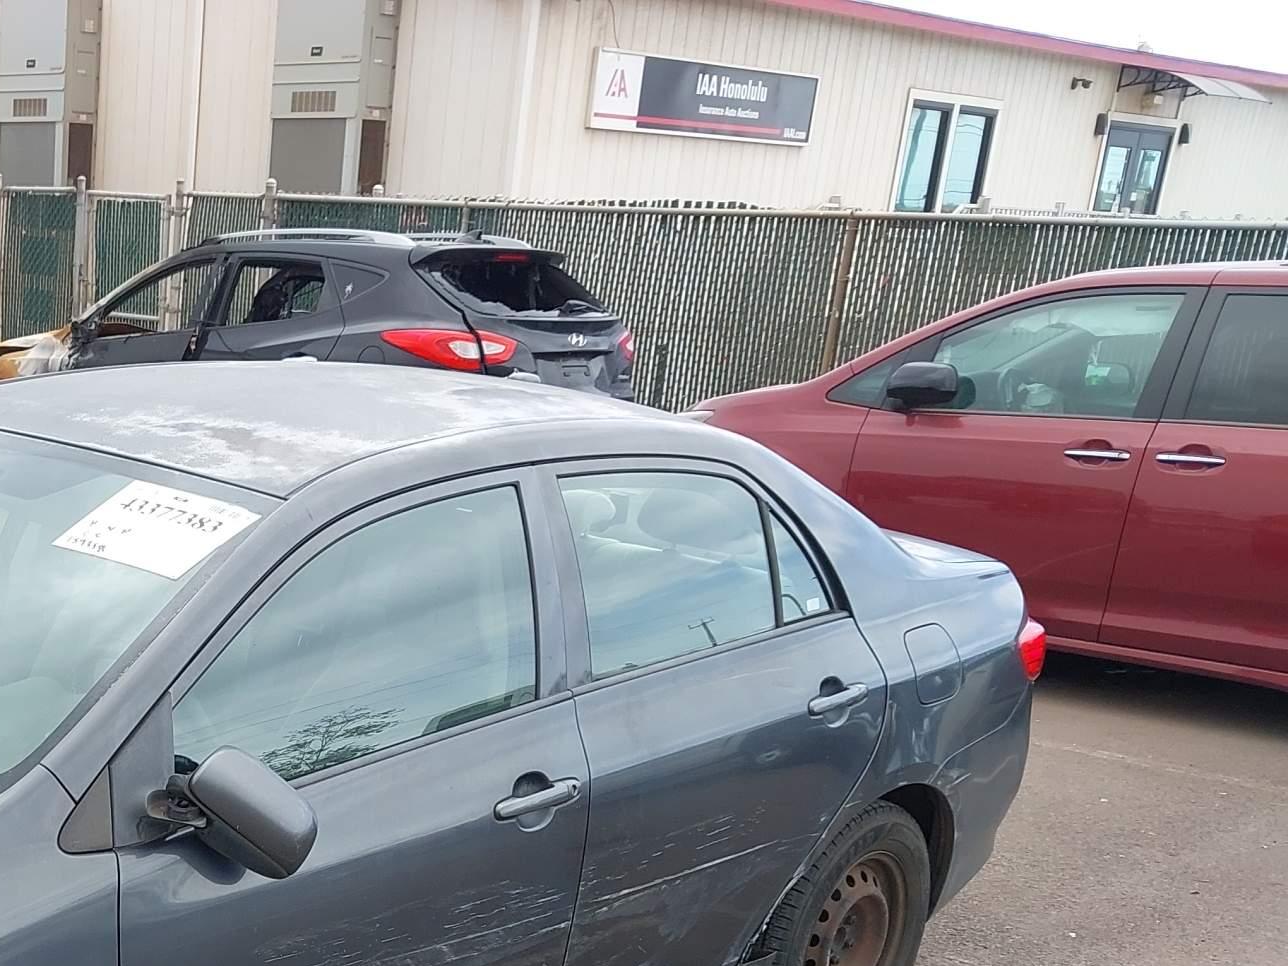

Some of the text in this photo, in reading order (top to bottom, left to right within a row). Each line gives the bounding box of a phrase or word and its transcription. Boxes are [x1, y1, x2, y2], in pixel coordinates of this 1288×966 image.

[696, 73, 768, 102] IAA Honolulu
[120, 498, 223, 533] 43377383
